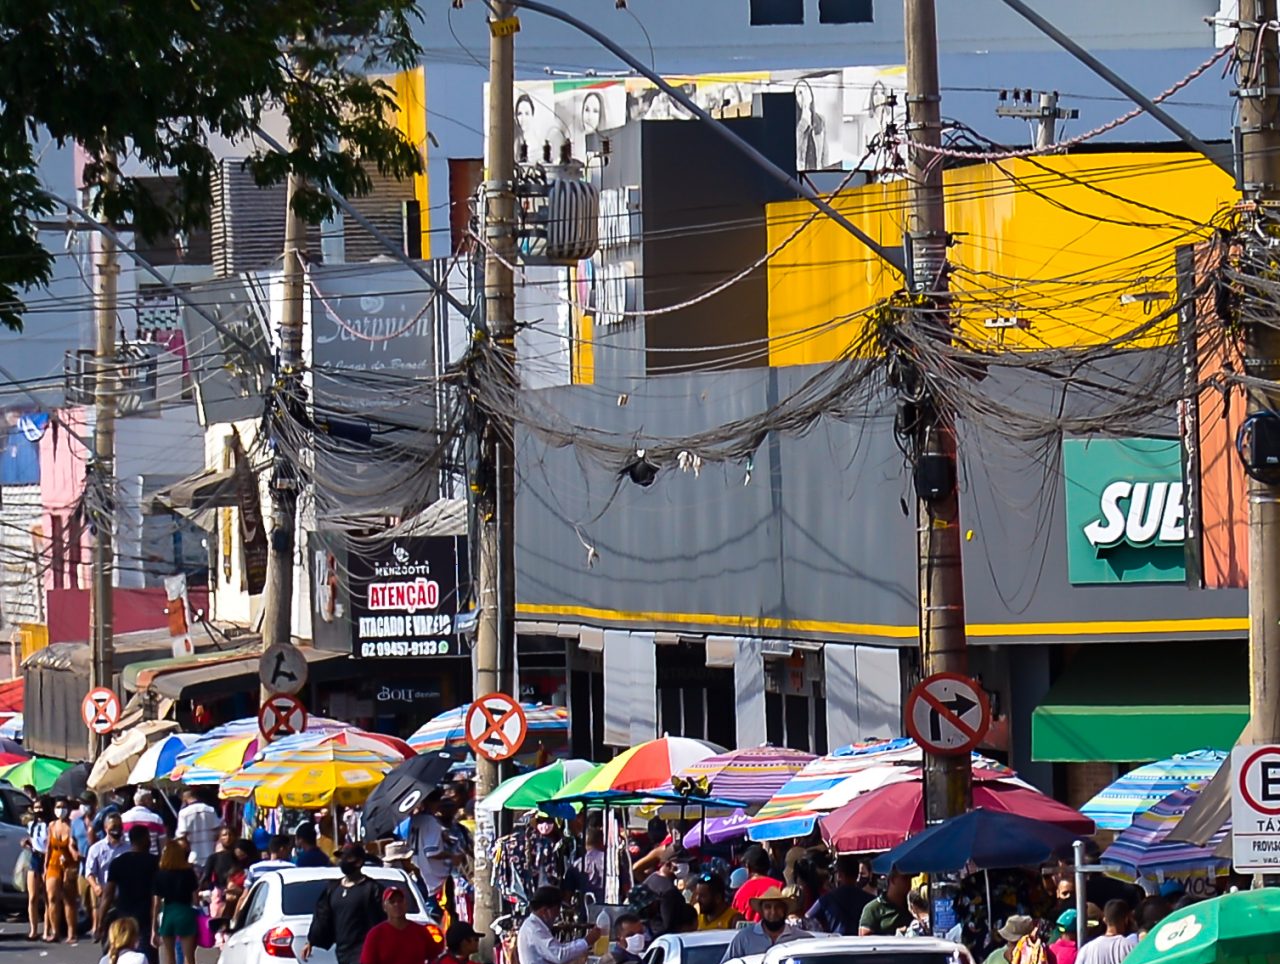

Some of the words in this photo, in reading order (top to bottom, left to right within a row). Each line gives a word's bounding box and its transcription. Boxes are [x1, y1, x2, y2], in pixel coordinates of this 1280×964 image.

[370, 579, 438, 612] ATENÇÃO
[359, 616, 404, 638] ATACADO
[405, 615, 413, 636] E
